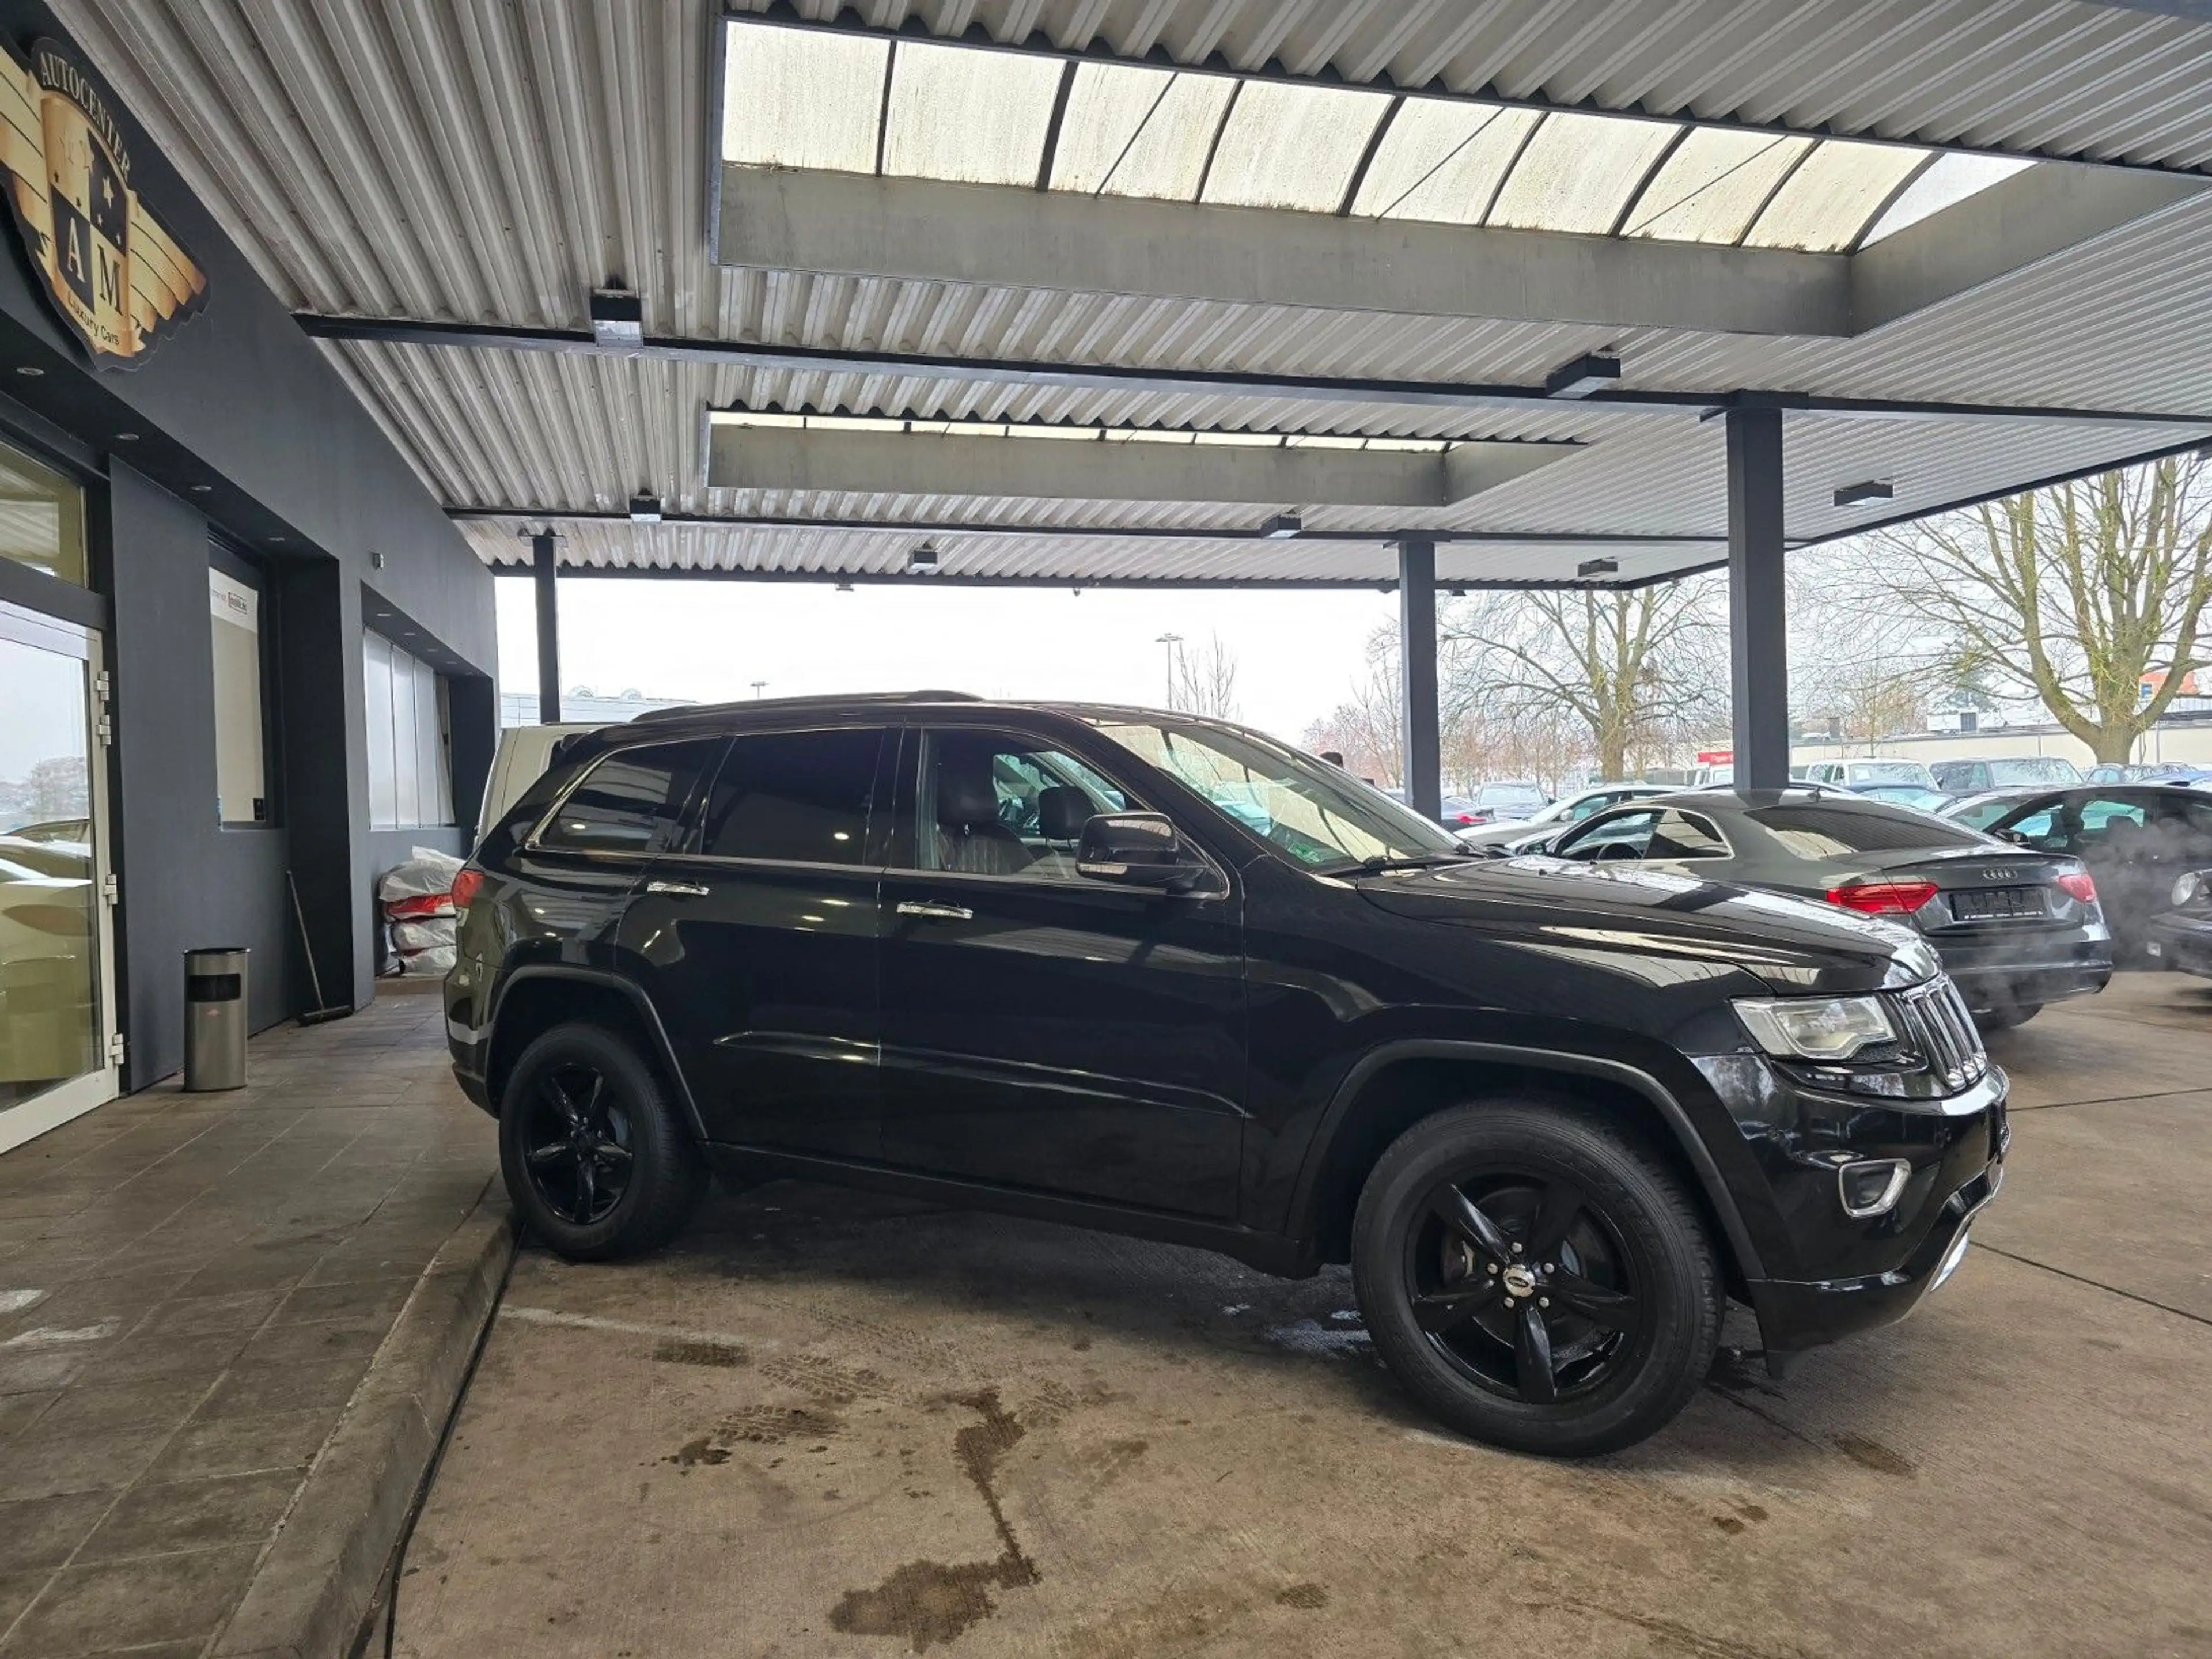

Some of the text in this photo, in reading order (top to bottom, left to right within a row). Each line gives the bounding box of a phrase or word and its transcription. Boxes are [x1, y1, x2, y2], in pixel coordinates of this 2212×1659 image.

[41, 52, 130, 183] AUTOCENTER
[67, 290, 120, 346] Luxury Cars
